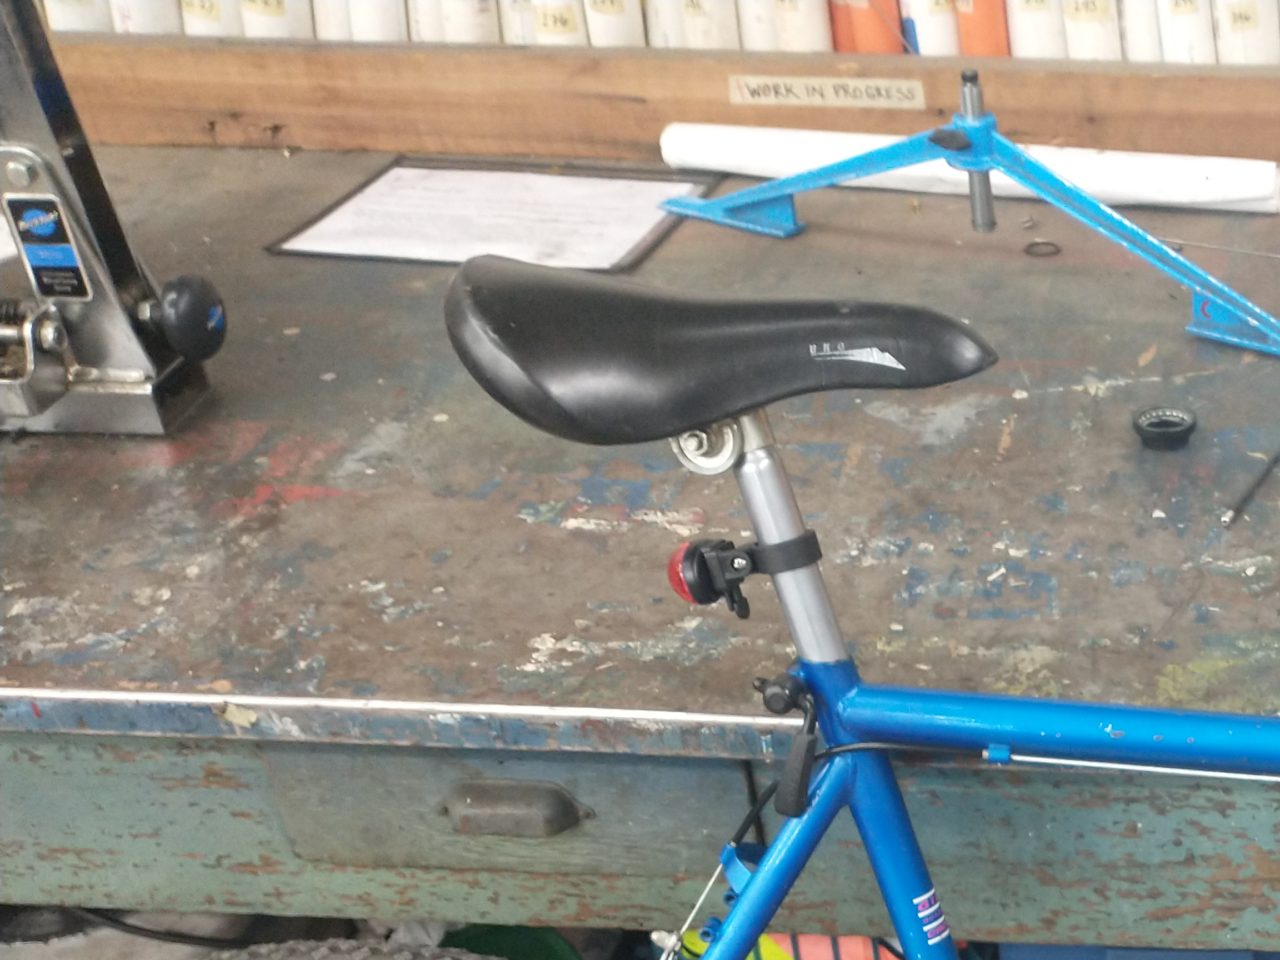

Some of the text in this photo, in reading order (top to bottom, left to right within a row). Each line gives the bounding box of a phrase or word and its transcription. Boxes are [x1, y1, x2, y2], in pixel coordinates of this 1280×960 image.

[744, 82, 916, 100] WORK IN PROGRESS
